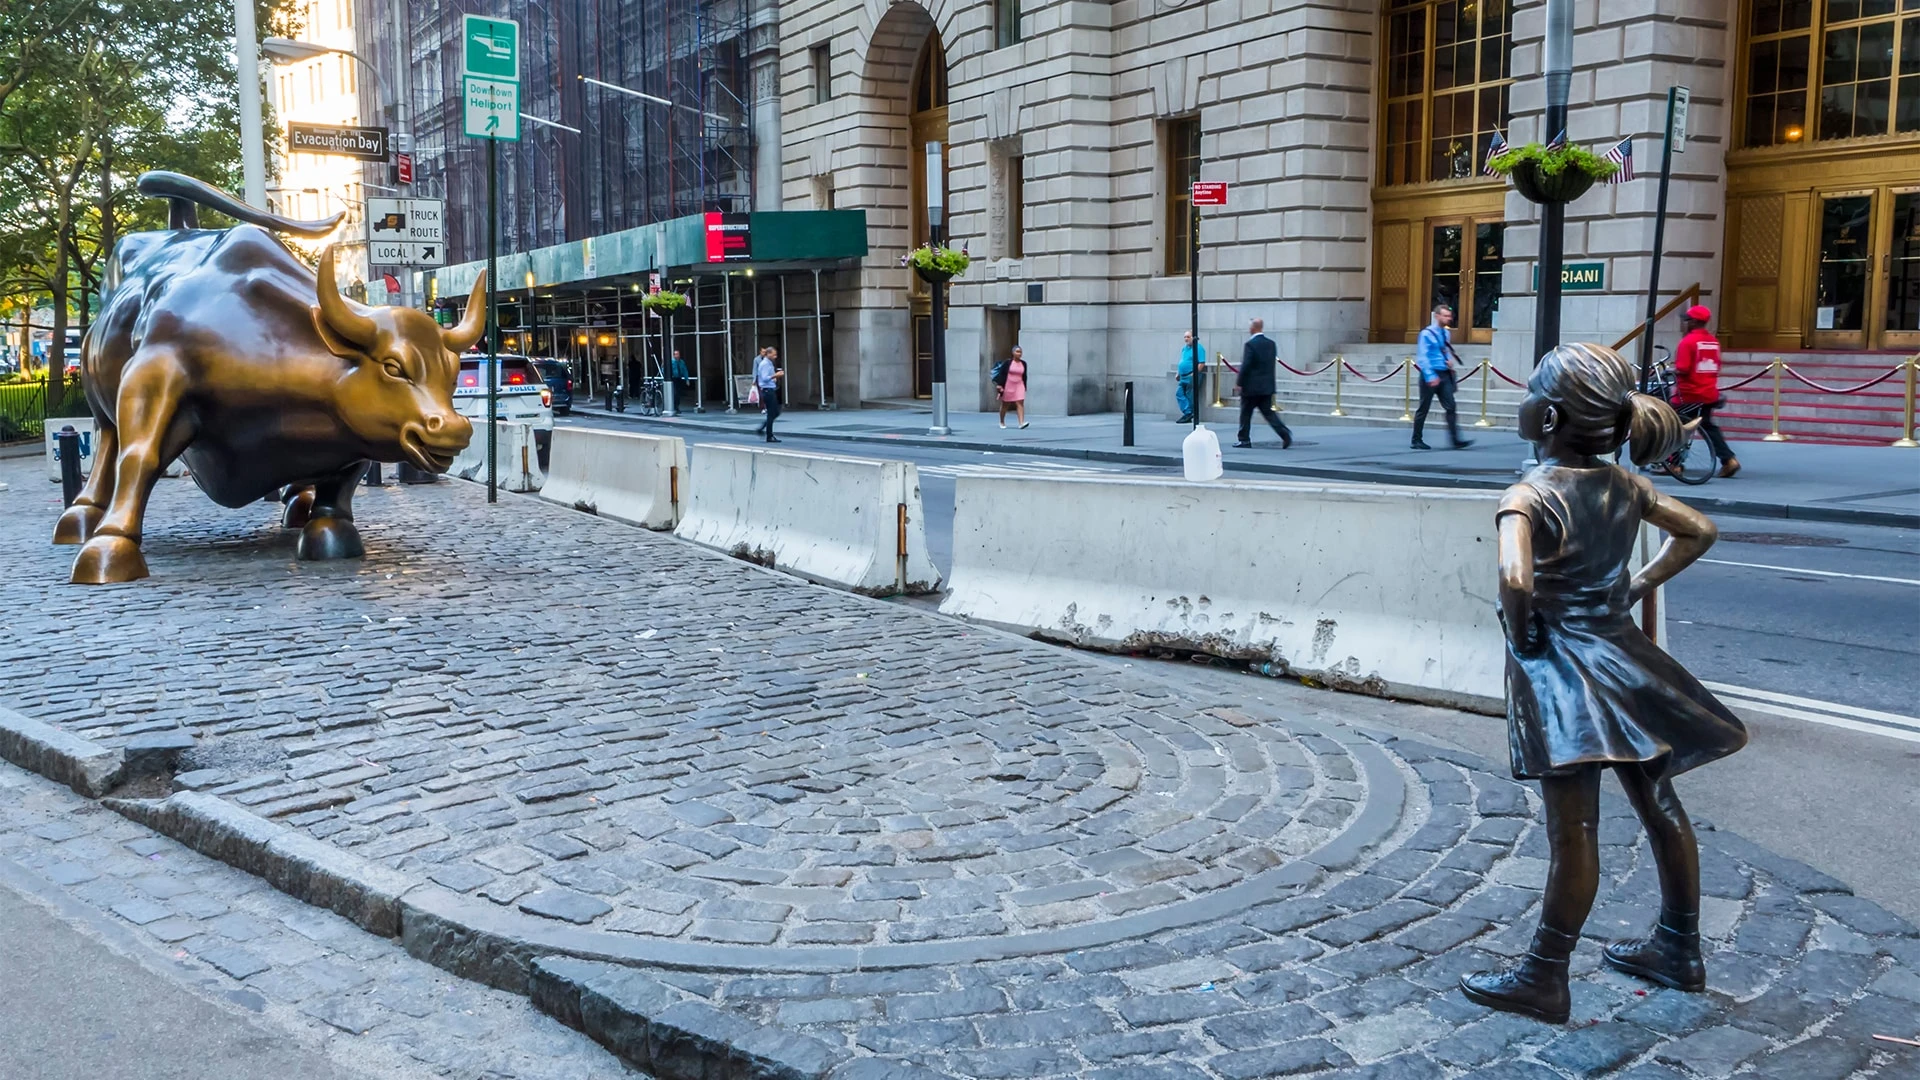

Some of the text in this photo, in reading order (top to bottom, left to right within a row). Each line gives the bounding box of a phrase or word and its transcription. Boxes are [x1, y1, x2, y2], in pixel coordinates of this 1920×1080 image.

[470, 98, 512, 111] Heliport
[294, 131, 379, 152] Evacuation Day
[410, 210, 439, 221] TRUCK
[410, 228, 439, 238] ROUTE
[378, 247, 409, 258] LOCAL
[1561, 269, 1599, 283] RIANI
